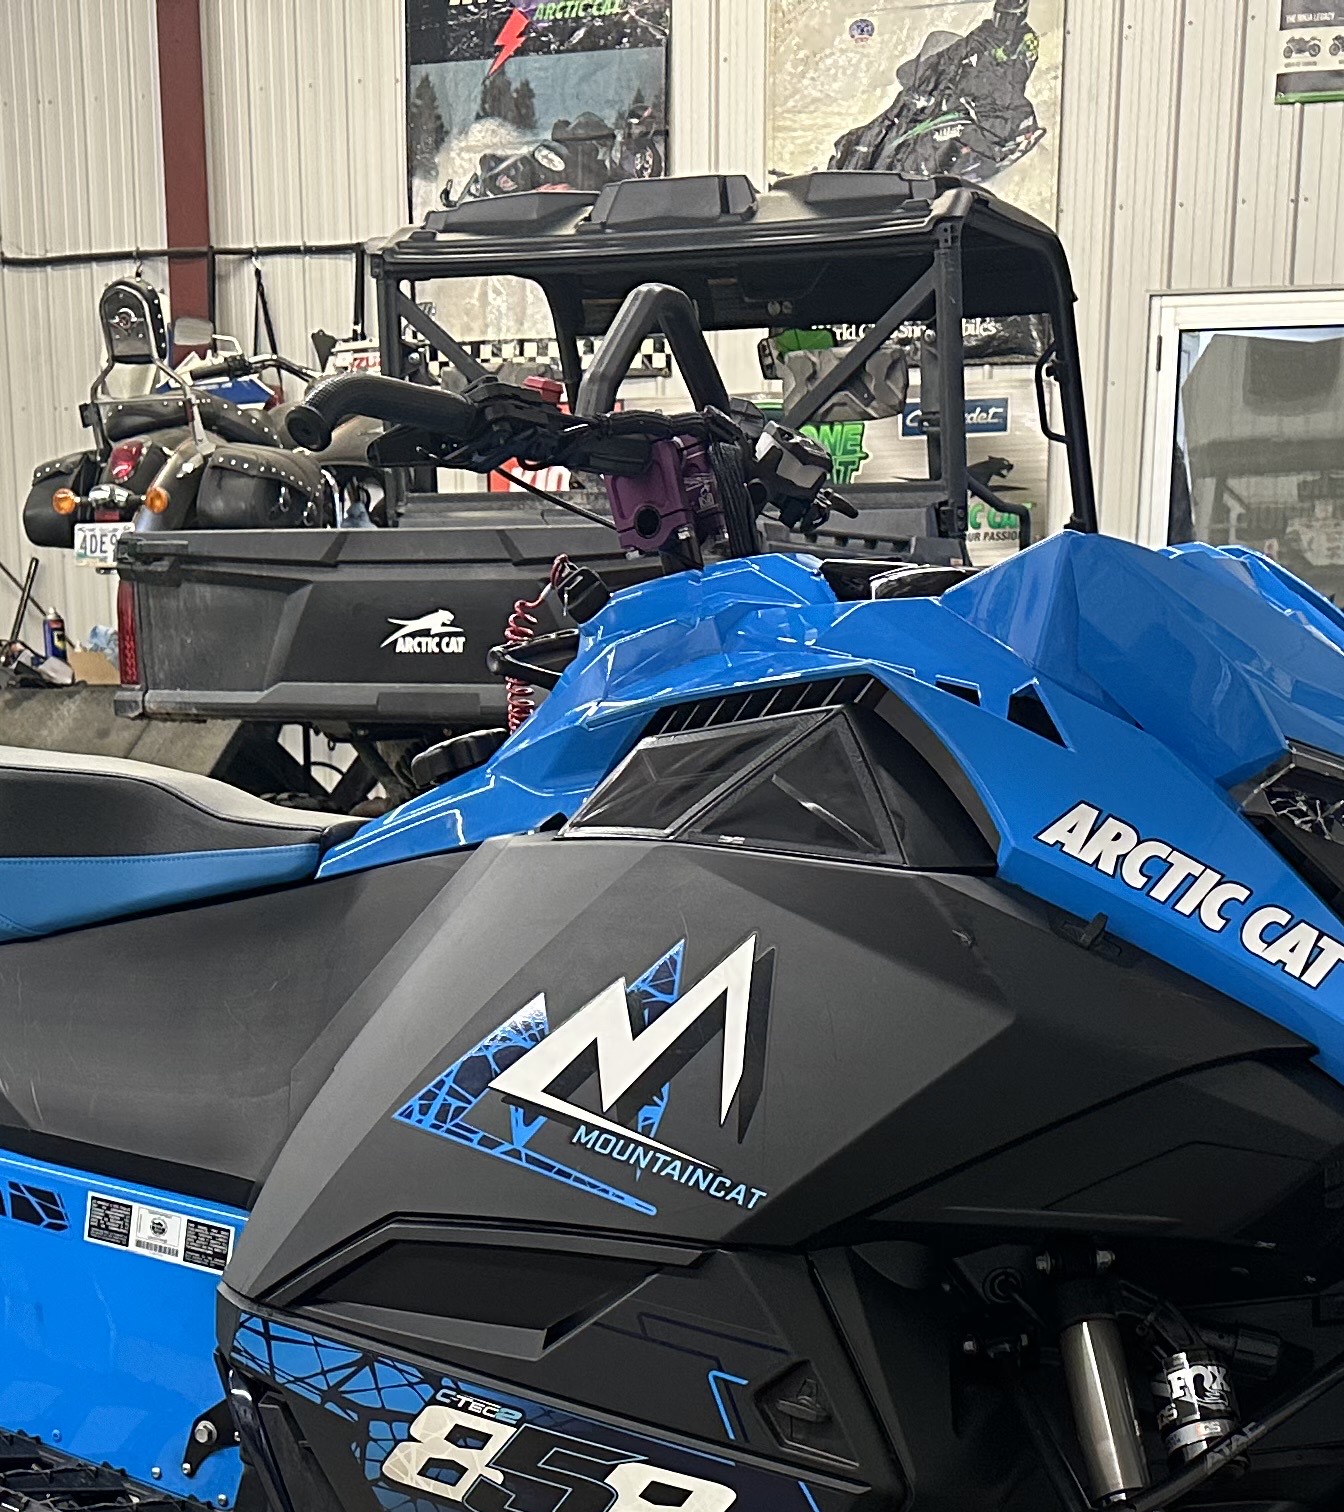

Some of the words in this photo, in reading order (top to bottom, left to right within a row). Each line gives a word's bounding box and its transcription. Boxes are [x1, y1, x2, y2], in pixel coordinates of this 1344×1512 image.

[533, 3, 586, 21] ARCTIC
[395, 637, 440, 653] ARCTIC
[441, 637, 466, 653] CAT
[1034, 800, 1253, 932] ARCTIC
[572, 1124, 767, 1210] MOUNTAINCAT
[435, 1388, 523, 1424] C-TEC2
[1168, 1365, 1231, 1409] FOX
